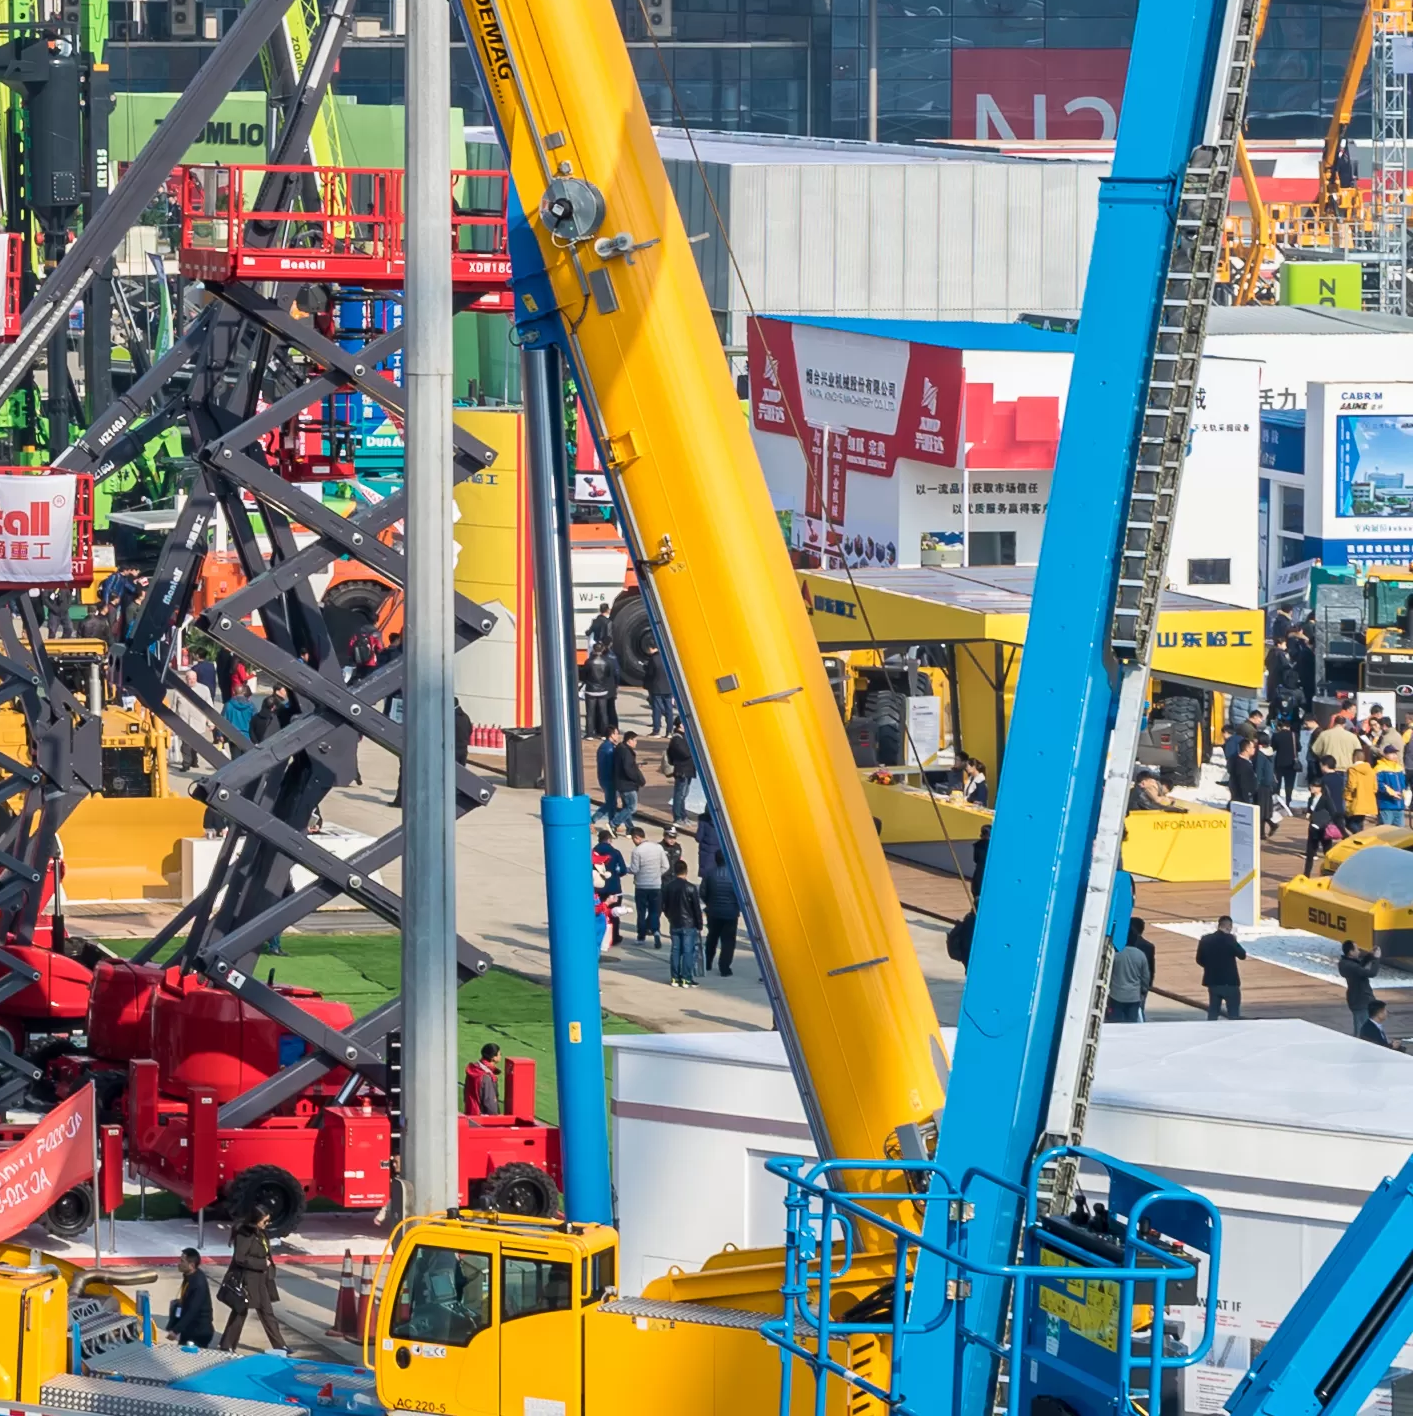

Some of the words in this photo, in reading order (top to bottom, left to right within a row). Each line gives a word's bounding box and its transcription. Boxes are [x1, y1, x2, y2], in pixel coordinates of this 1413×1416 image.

[98, 416, 127, 446] HZ140J
[366, 435, 404, 448] DunA
[1156, 630, 1252, 648] 山东临工
[1153, 820, 1227, 831] INFORMATION
[1308, 907, 1347, 933] SDLG
[1196, 1297, 1229, 1312] WAT
[1232, 1300, 1242, 1312] IF
[397, 1398, 412, 1408] AC
[416, 1400, 446, 1413] 220-5
